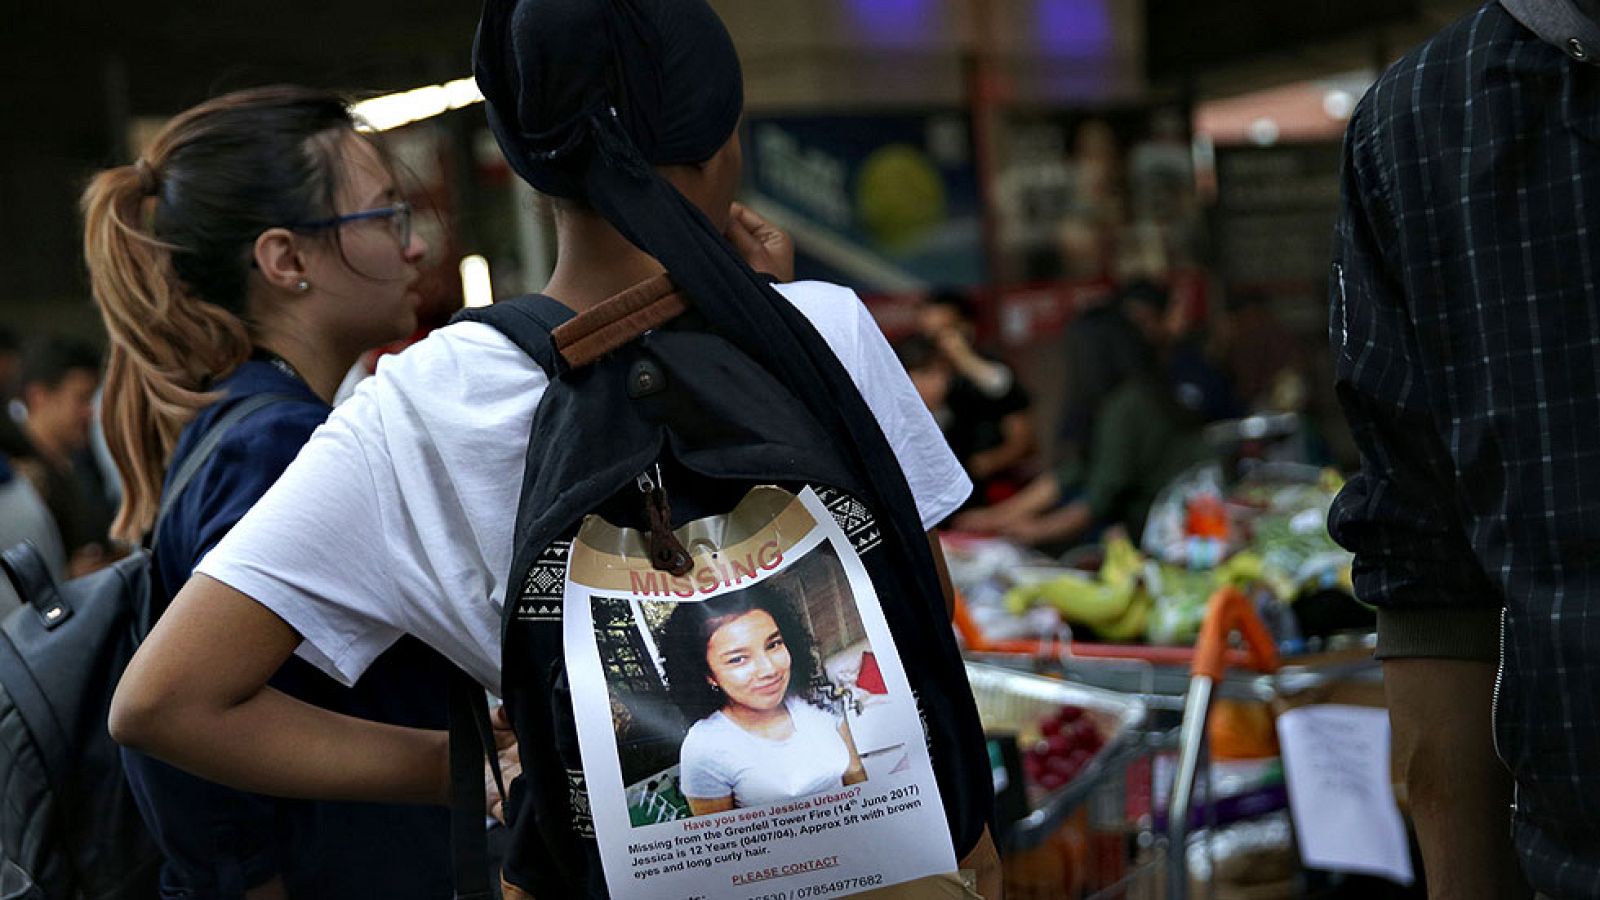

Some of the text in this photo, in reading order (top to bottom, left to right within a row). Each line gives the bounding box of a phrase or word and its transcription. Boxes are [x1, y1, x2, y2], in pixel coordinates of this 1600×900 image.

[630, 541, 783, 598] MISSING
[628, 784, 919, 854] Missing from the Grenfell Tower Fire (14th June 2017)
[631, 853, 674, 867] Jessica
[676, 848, 687, 859] is
[690, 845, 702, 856] 12
[705, 841, 738, 852] Years
[800, 819, 841, 835] Approx
[843, 814, 859, 826] 5ft
[860, 808, 885, 821] with
[887, 800, 922, 815] brown
[683, 787, 861, 831] Have you seen Jessica Urbano?
[634, 847, 771, 879] eyes and long curly hair.
[732, 856, 839, 885] PLEASE CONTACT
